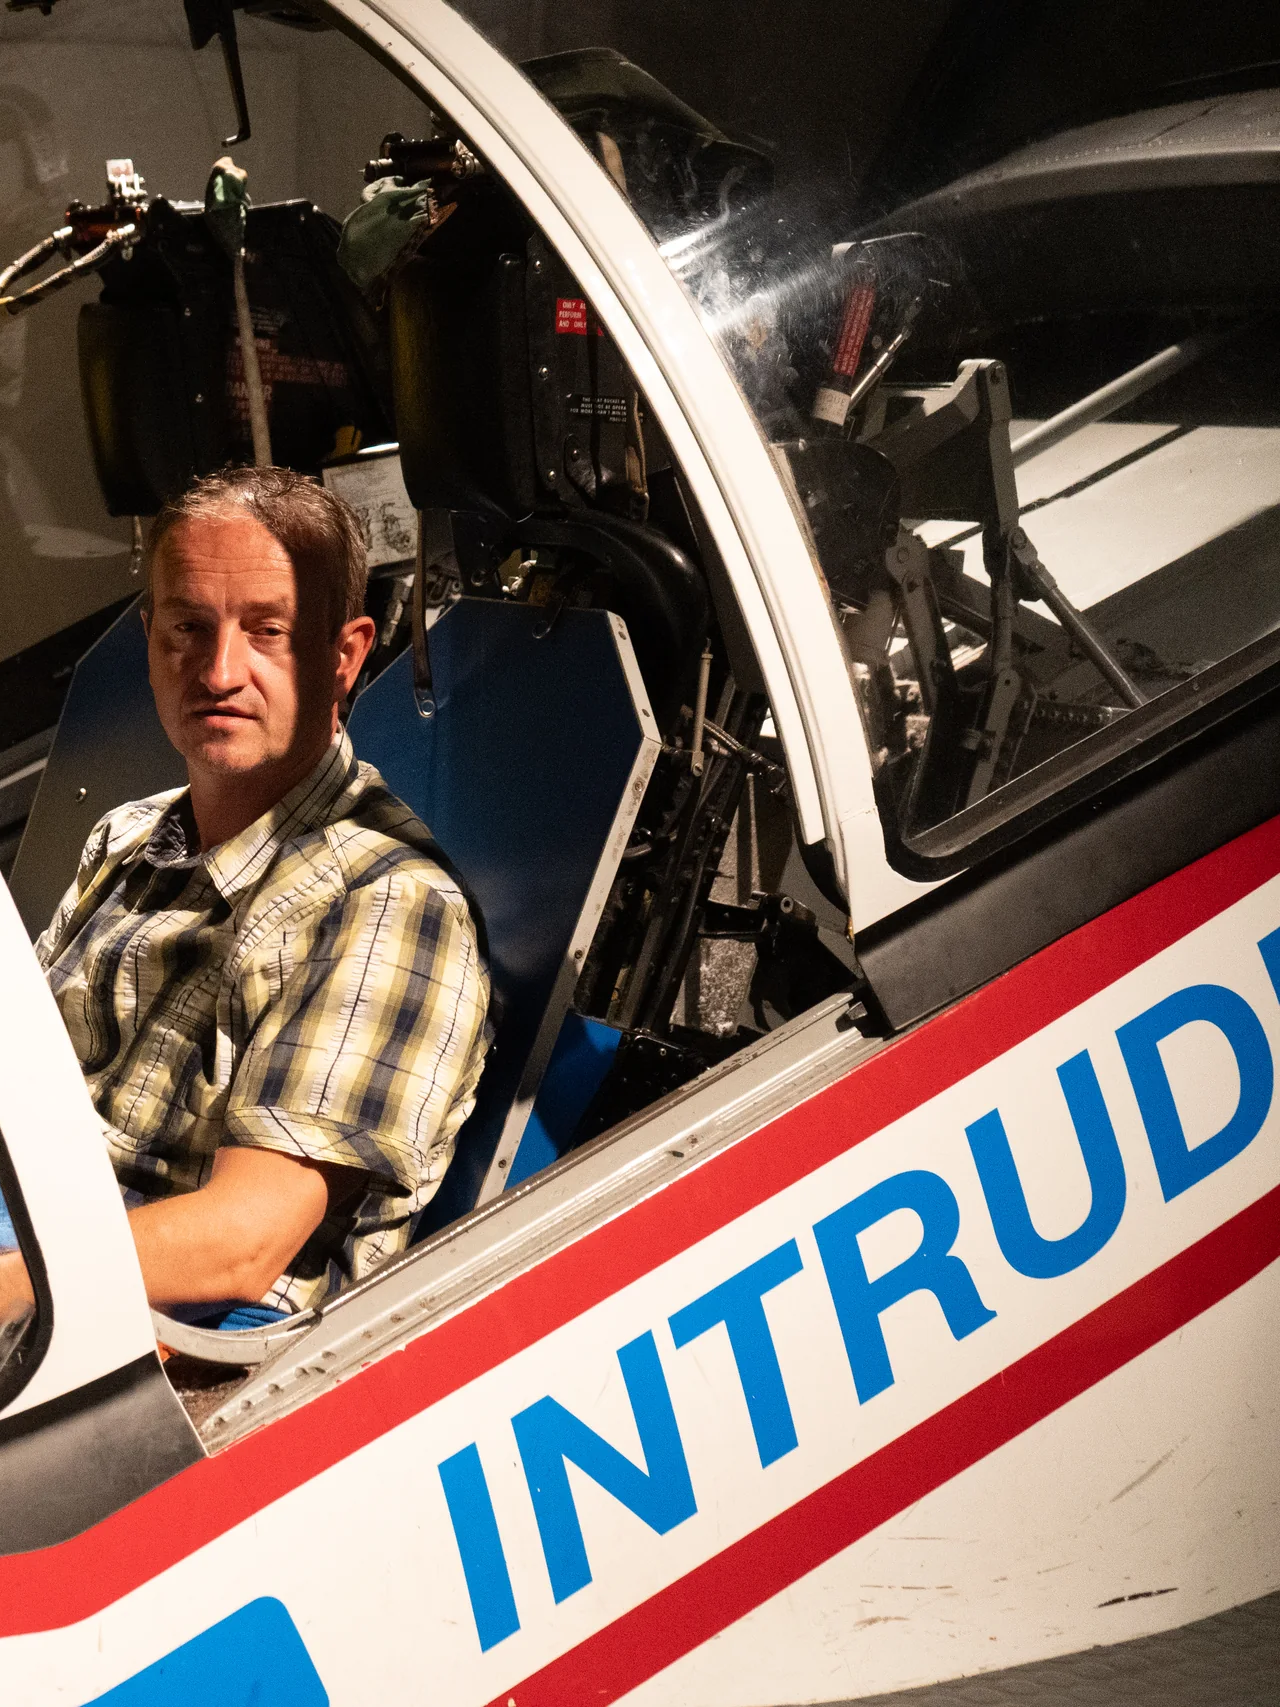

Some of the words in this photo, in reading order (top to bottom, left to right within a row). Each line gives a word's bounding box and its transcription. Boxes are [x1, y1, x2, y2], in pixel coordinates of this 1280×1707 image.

[562, 301, 576, 309] ONLY
[558, 319, 570, 328] AND
[437, 926, 1280, 1653] INTRUD
